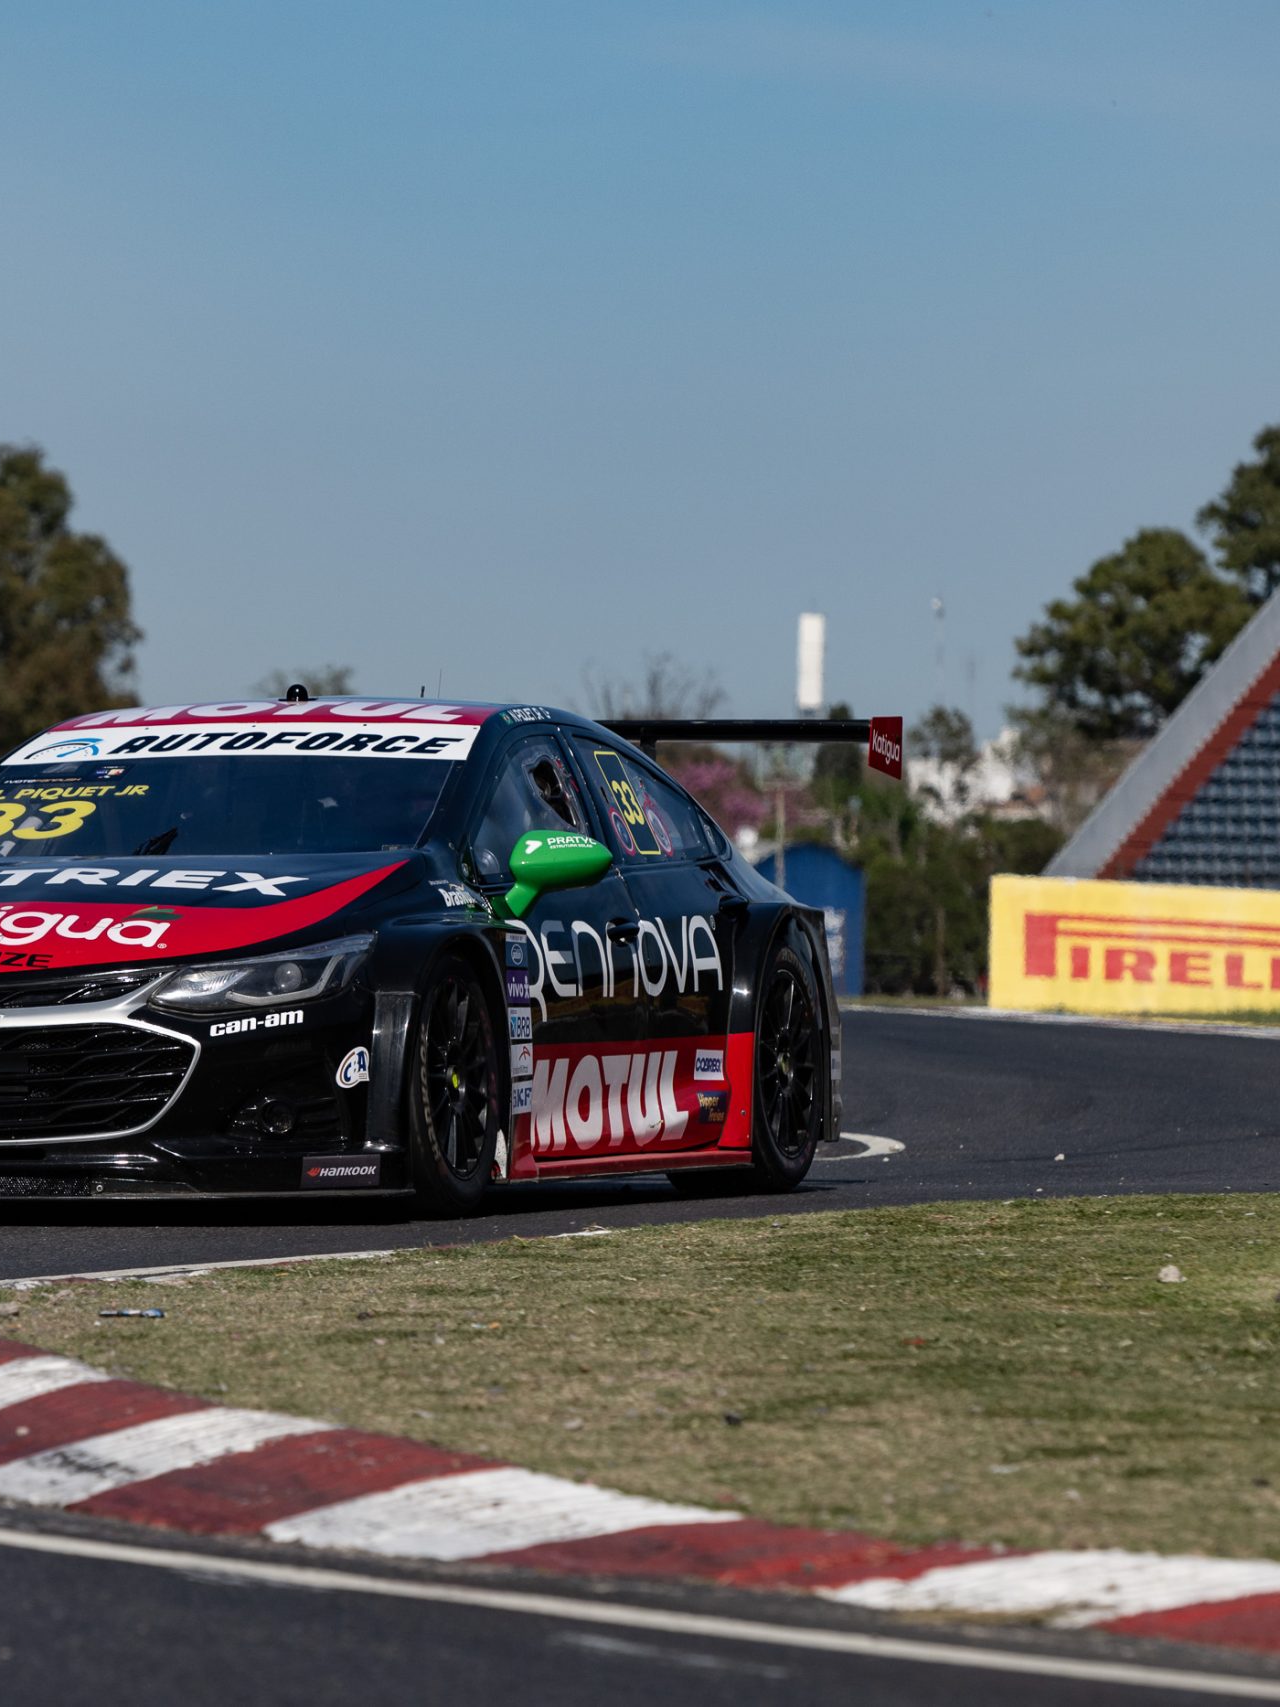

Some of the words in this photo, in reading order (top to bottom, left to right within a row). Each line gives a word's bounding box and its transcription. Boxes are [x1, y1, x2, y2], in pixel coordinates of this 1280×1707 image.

[73, 701, 463, 728] MOTUL
[106, 731, 466, 755] AUTOFORCE
[14, 785, 116, 800] PIQUET
[114, 785, 150, 797] JR
[611, 780, 645, 825] 33
[1025, 913, 1280, 990] PIREL
[507, 976, 524, 998] vivo
[209, 1009, 304, 1037] can-am
[517, 1016, 531, 1038] BRB
[530, 1050, 689, 1152] MOTUL
